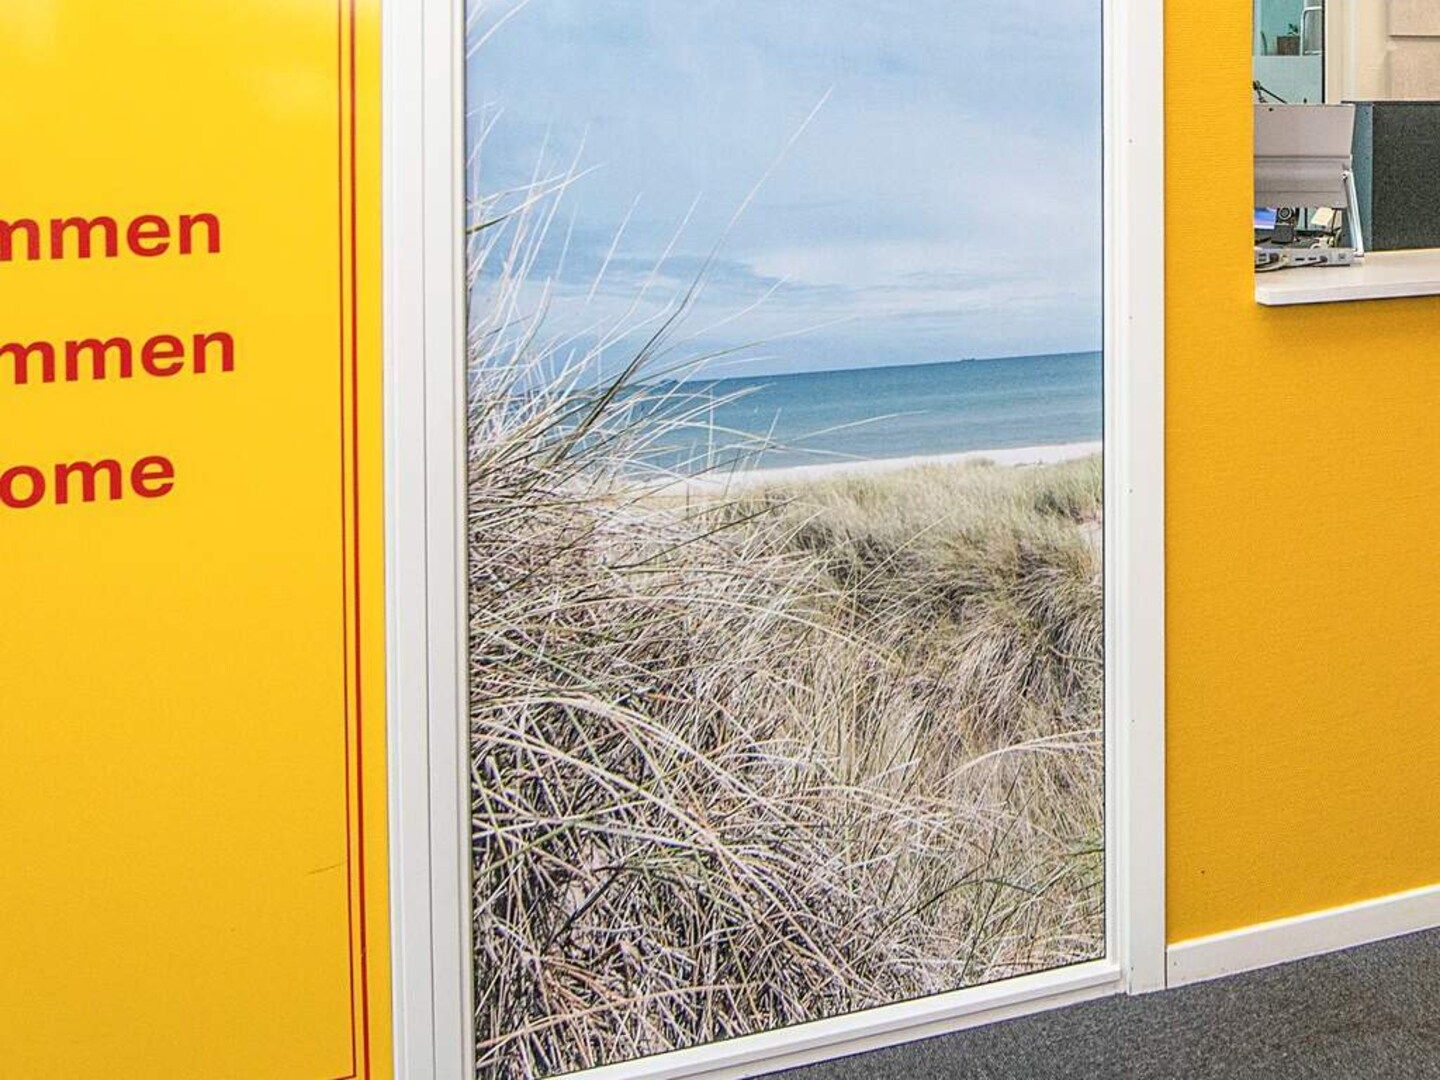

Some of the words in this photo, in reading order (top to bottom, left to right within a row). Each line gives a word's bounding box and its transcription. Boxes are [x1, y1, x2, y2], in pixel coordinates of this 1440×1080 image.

[0, 212, 221, 262] mmen
[0, 331, 235, 385] mmen
[0, 455, 175, 509] ome
